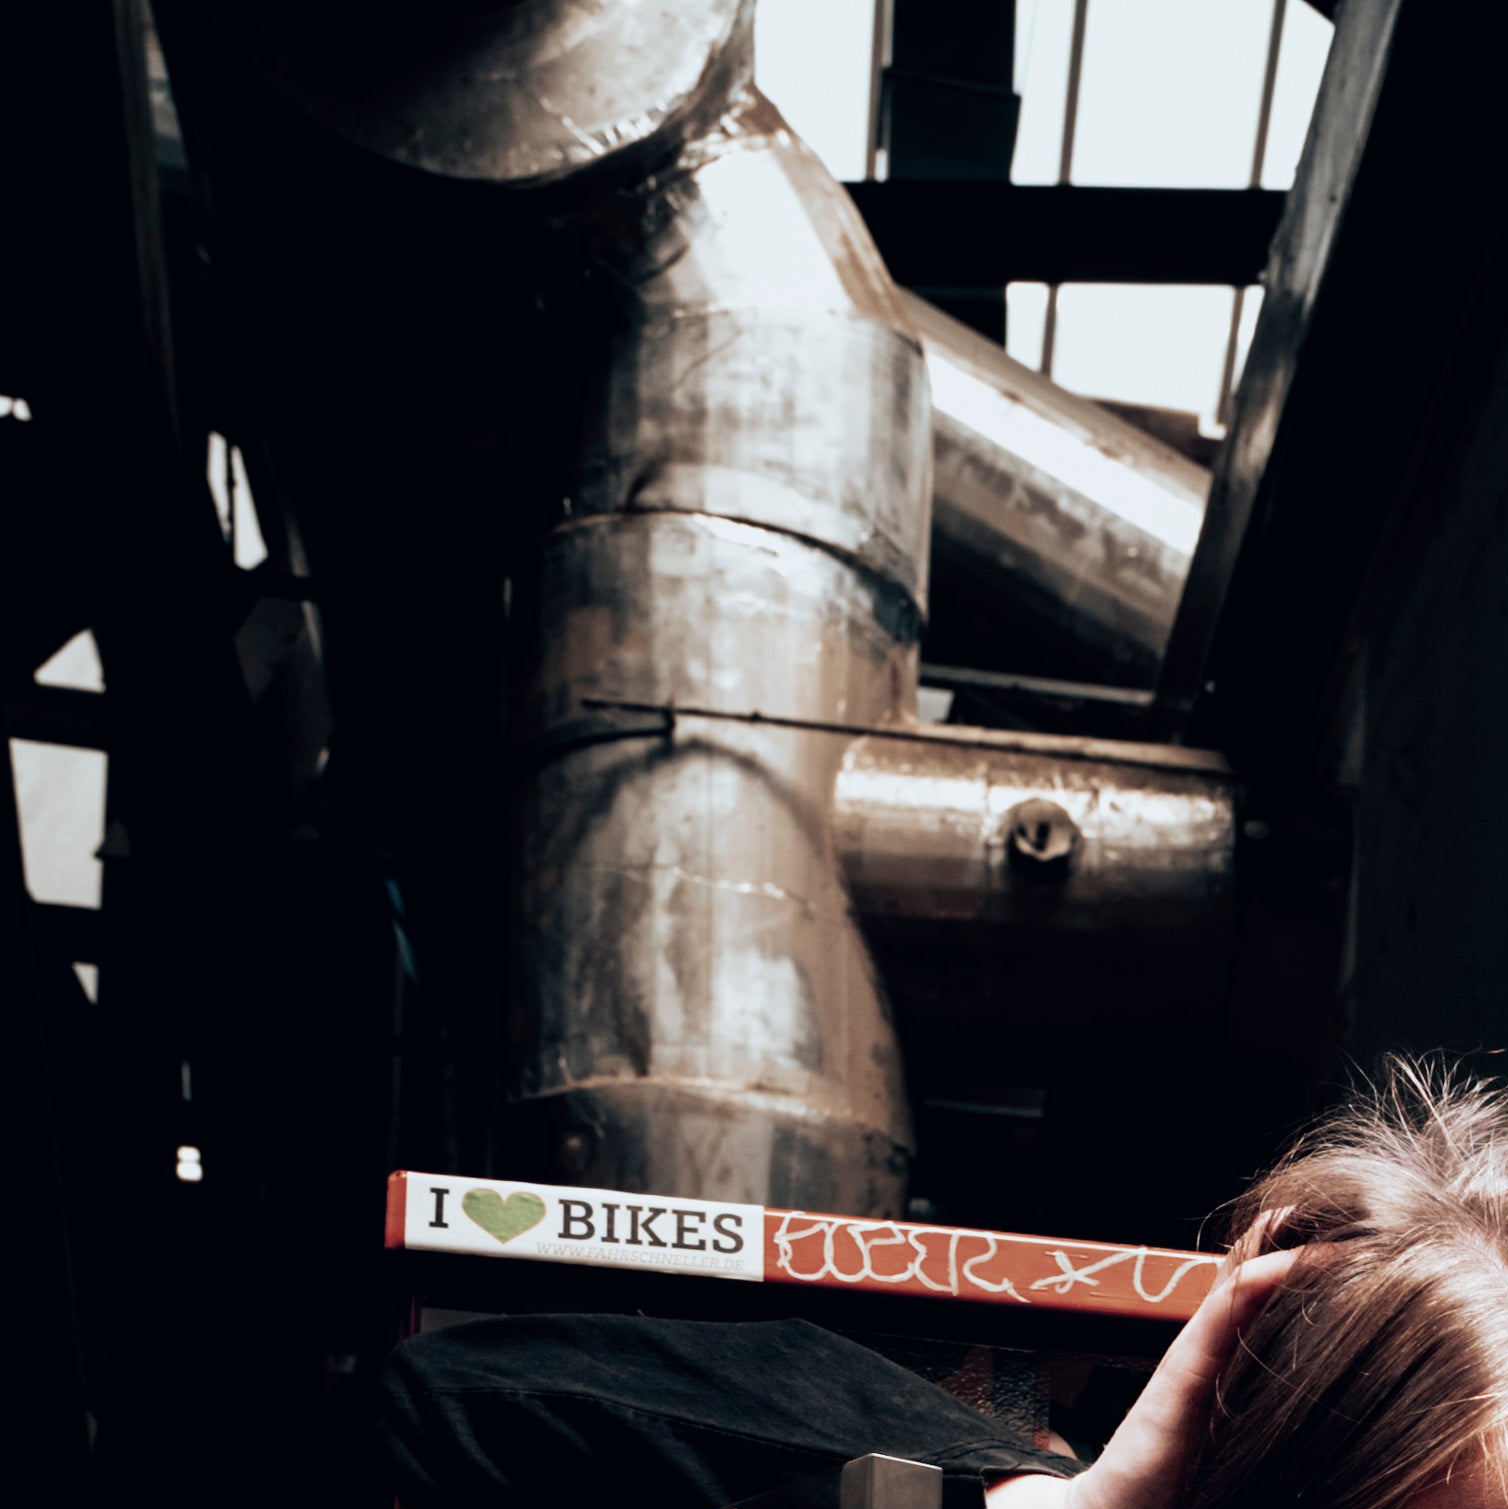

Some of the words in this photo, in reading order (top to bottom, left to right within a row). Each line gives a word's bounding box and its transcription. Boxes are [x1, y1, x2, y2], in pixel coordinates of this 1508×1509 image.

[429, 1187, 449, 1228] I
[558, 1199, 744, 1254] BIKES
[536, 1242, 744, 1272] WWW.FAHRSCHNELLER.DE
